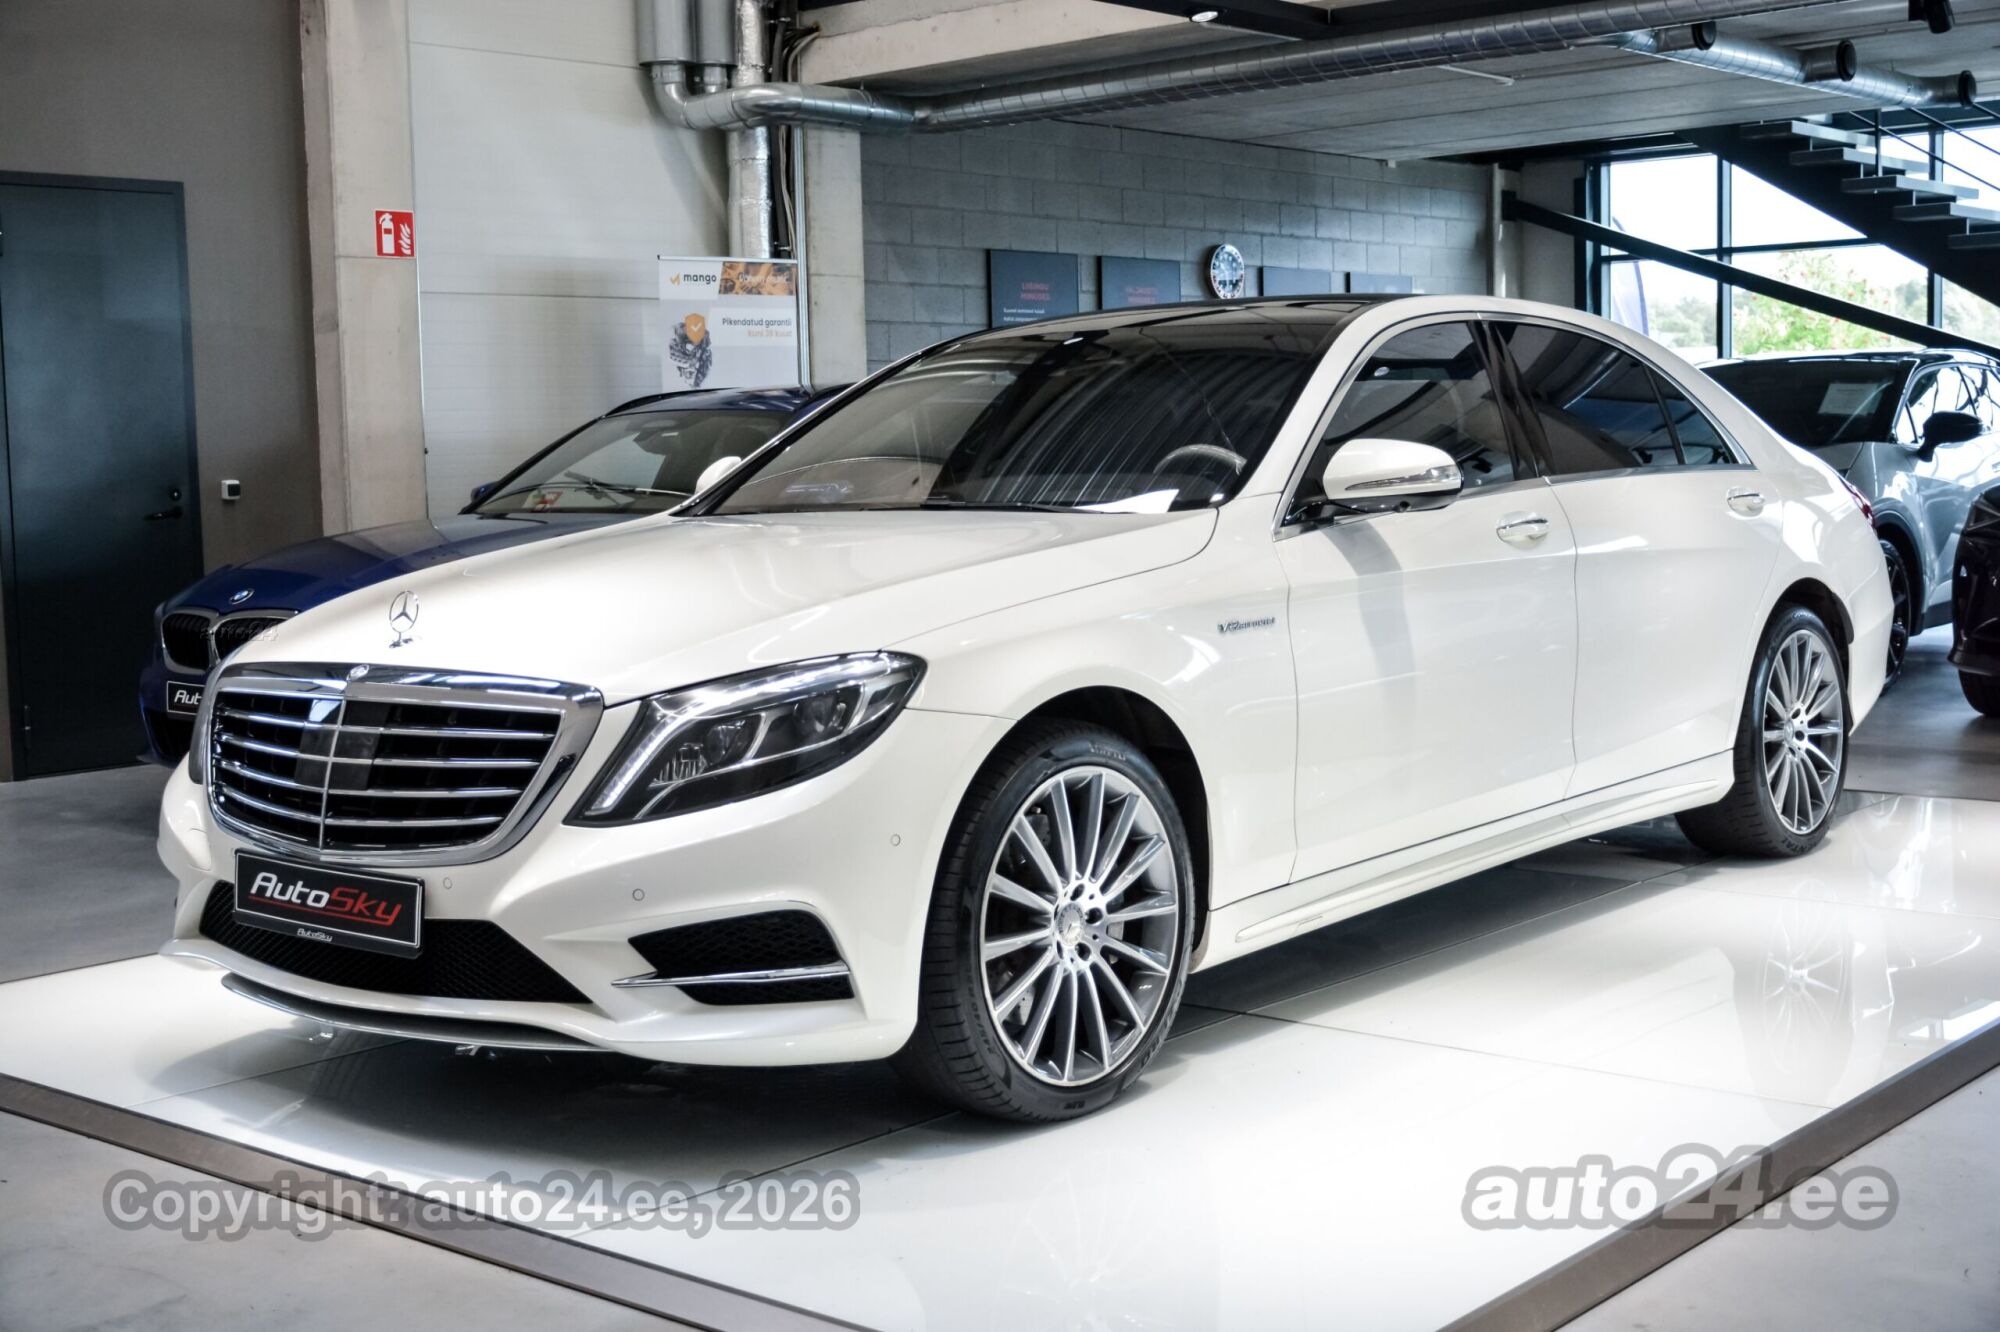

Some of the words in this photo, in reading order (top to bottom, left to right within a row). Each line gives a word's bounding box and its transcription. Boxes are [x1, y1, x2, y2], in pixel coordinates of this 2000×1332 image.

[683, 273, 717, 285] mango
[722, 317, 763, 326] Pikendatud
[249, 871, 402, 926] AutoSky
